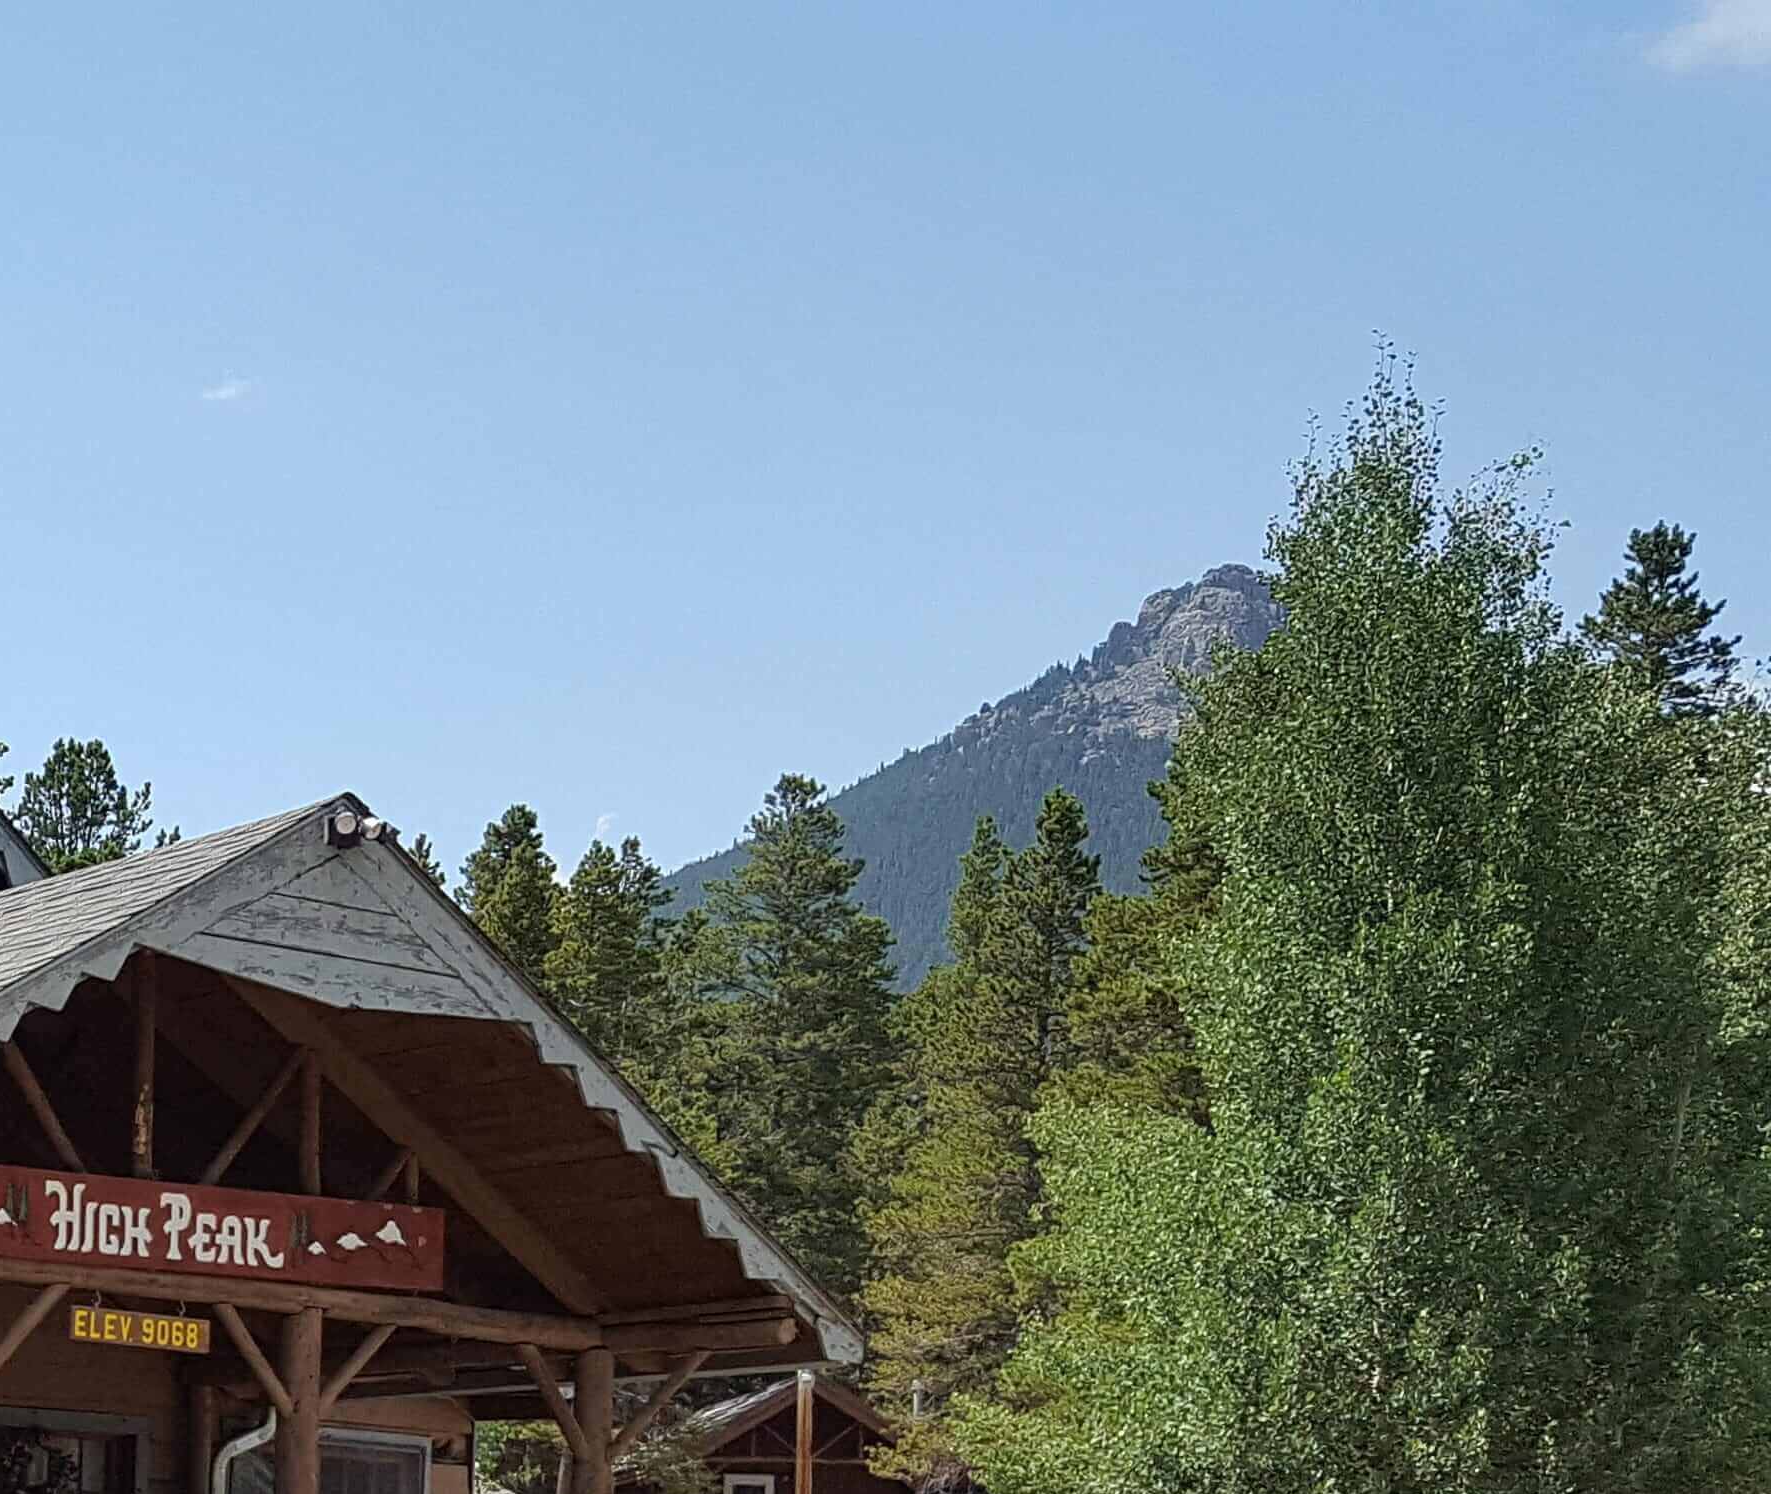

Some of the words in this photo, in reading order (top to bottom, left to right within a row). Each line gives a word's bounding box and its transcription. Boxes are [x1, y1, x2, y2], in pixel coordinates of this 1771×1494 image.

[45, 1180, 153, 1257] HIGH
[160, 1192, 285, 1268] PEAK
[74, 1309, 133, 1343] ELEV.
[142, 1318, 198, 1349] 9068
